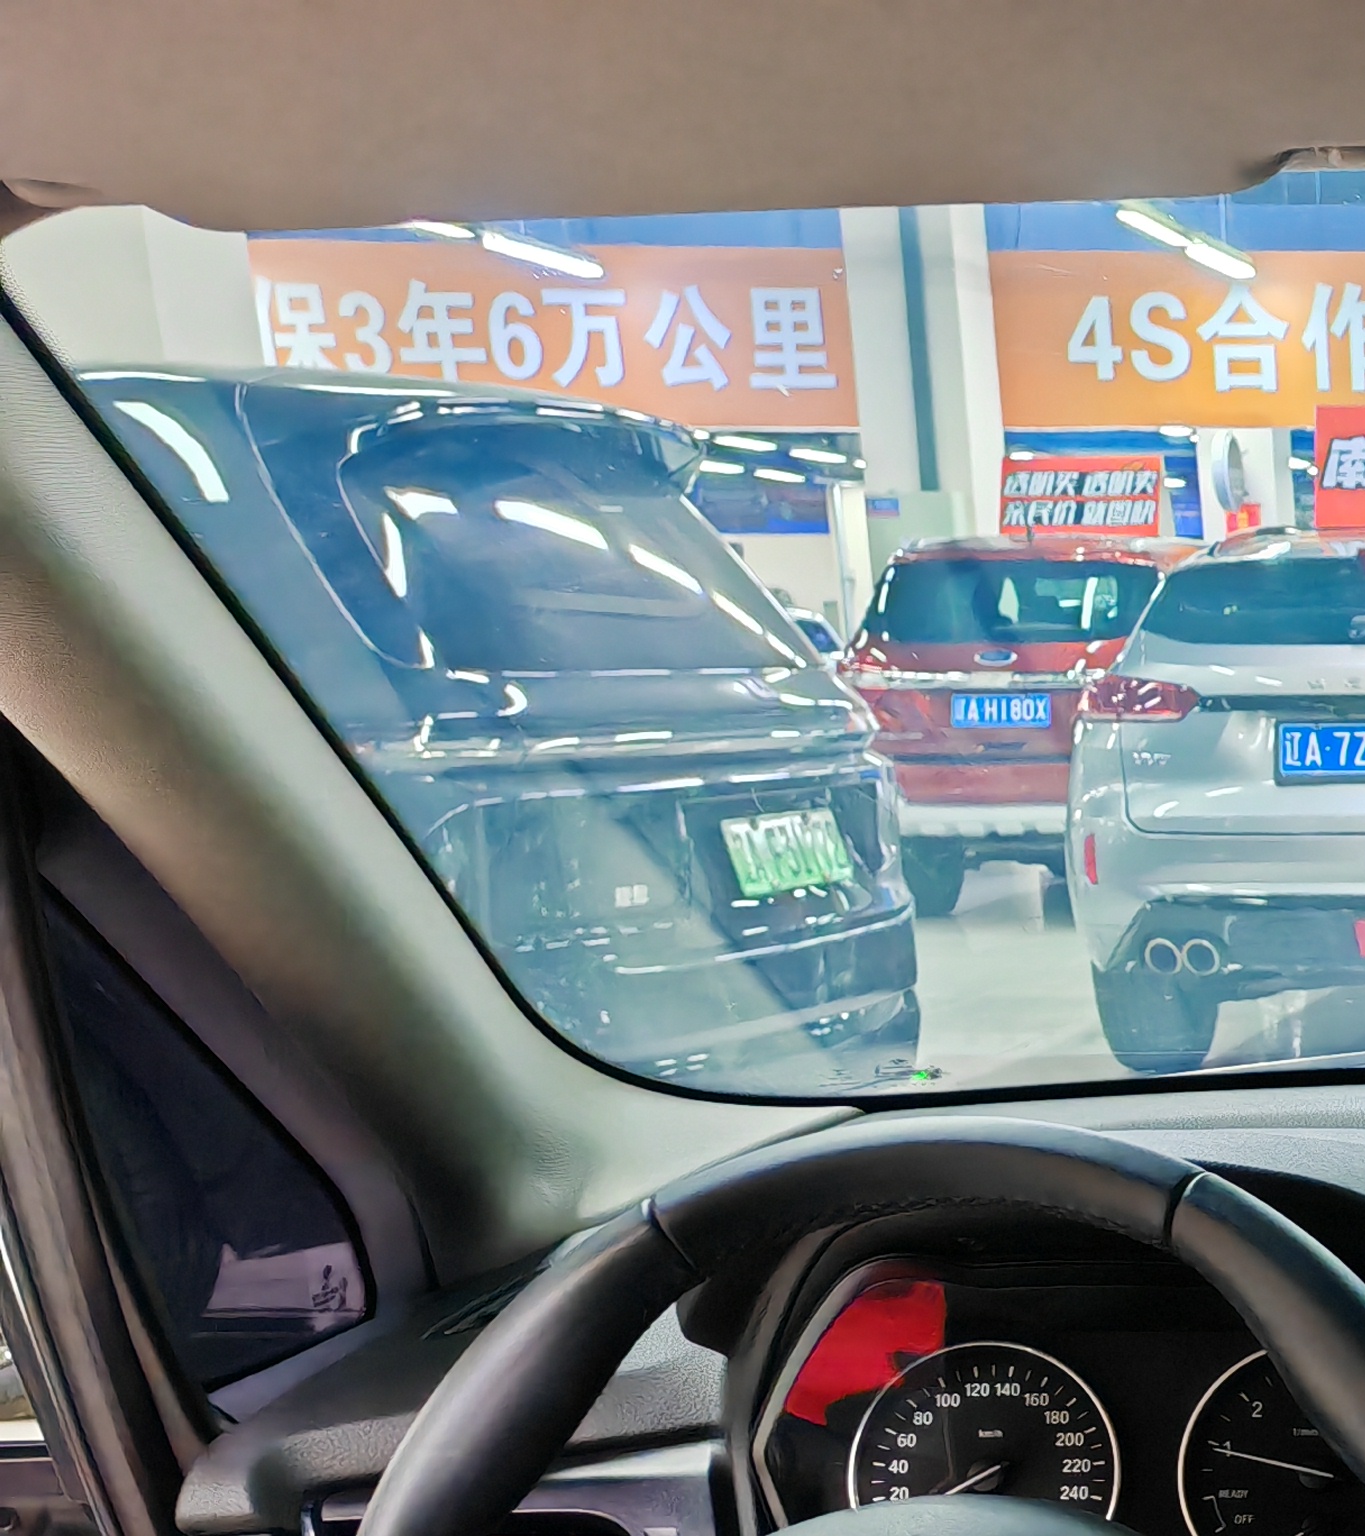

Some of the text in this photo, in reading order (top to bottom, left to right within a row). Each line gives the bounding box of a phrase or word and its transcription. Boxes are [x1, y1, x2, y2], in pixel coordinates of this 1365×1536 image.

[255, 276, 837, 389] 保3年6万公里
[964, 1383, 990, 1397] 120
[995, 1383, 1021, 1396] 140
[935, 1393, 960, 1408] 100
[1024, 1393, 1049, 1406] 160
[1044, 1410, 1069, 1425] 180
[1252, 1402, 1263, 1418] 2
[913, 1411, 933, 1426] 80
[897, 1433, 917, 1448] 60
[1055, 1432, 1084, 1447] 200
[888, 1460, 909, 1474] 40
[1062, 1459, 1091, 1473] 220
[890, 1486, 909, 1500] 20
[1060, 1485, 1088, 1500] 240
[1234, 1514, 1255, 1524] OFF
